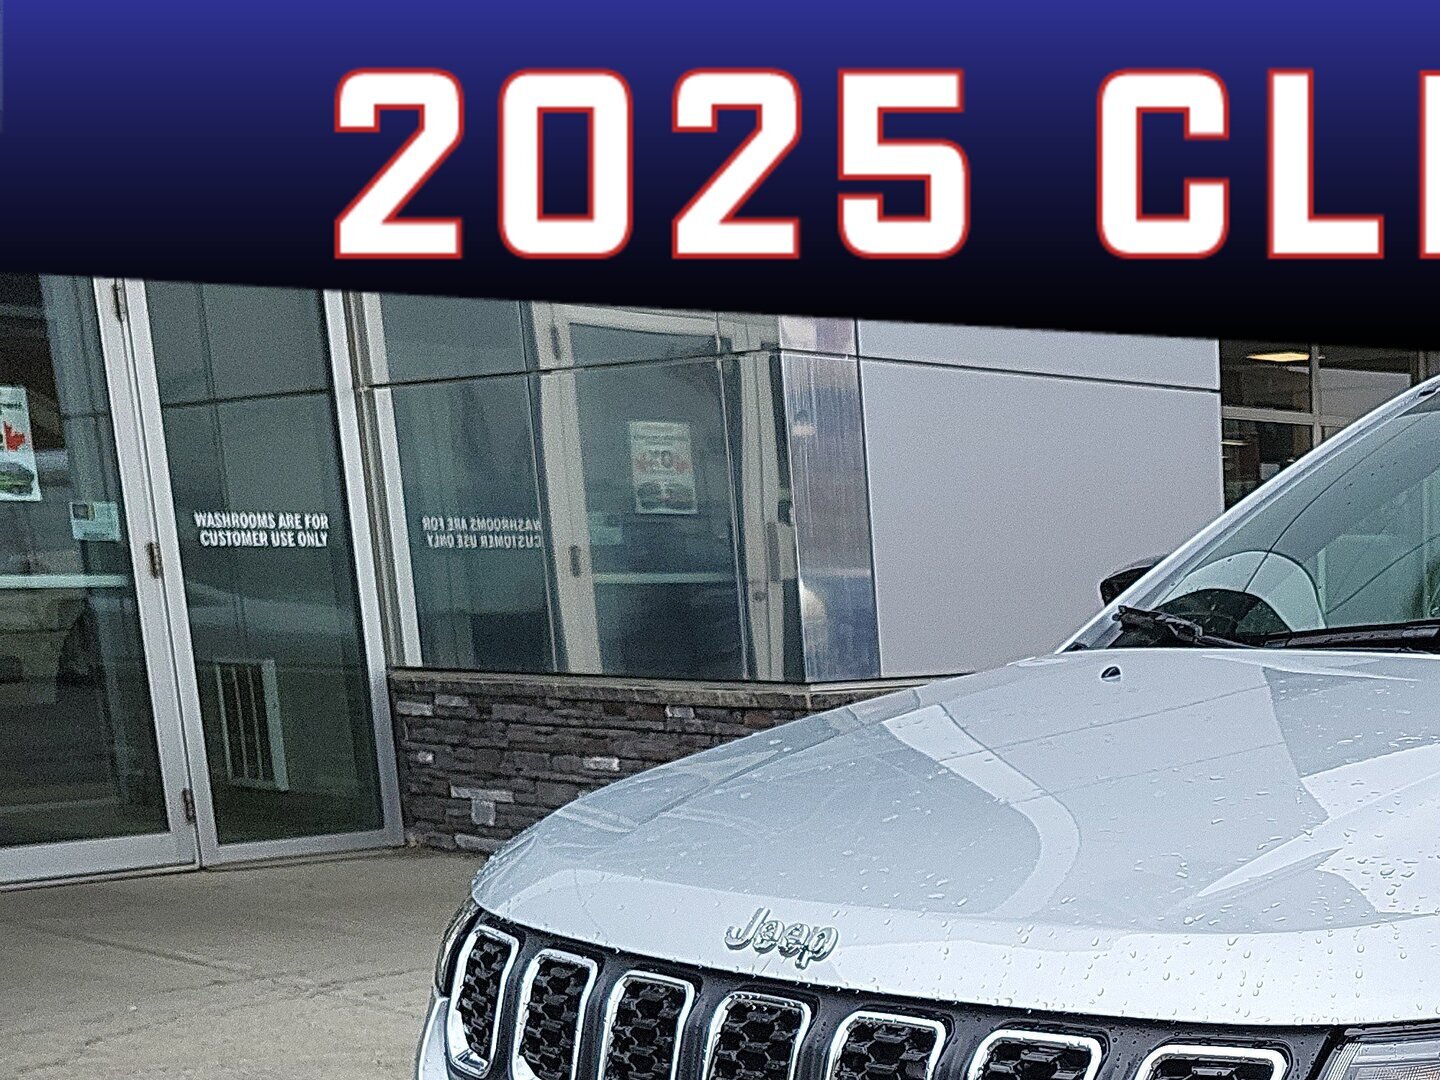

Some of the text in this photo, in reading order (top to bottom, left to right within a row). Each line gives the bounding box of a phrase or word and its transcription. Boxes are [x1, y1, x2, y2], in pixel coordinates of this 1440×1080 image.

[193, 510, 329, 530] WASHROOMS ARE FOR
[200, 529, 328, 548] CUSTOMER USE ONLY
[724, 906, 839, 970] Jeep
